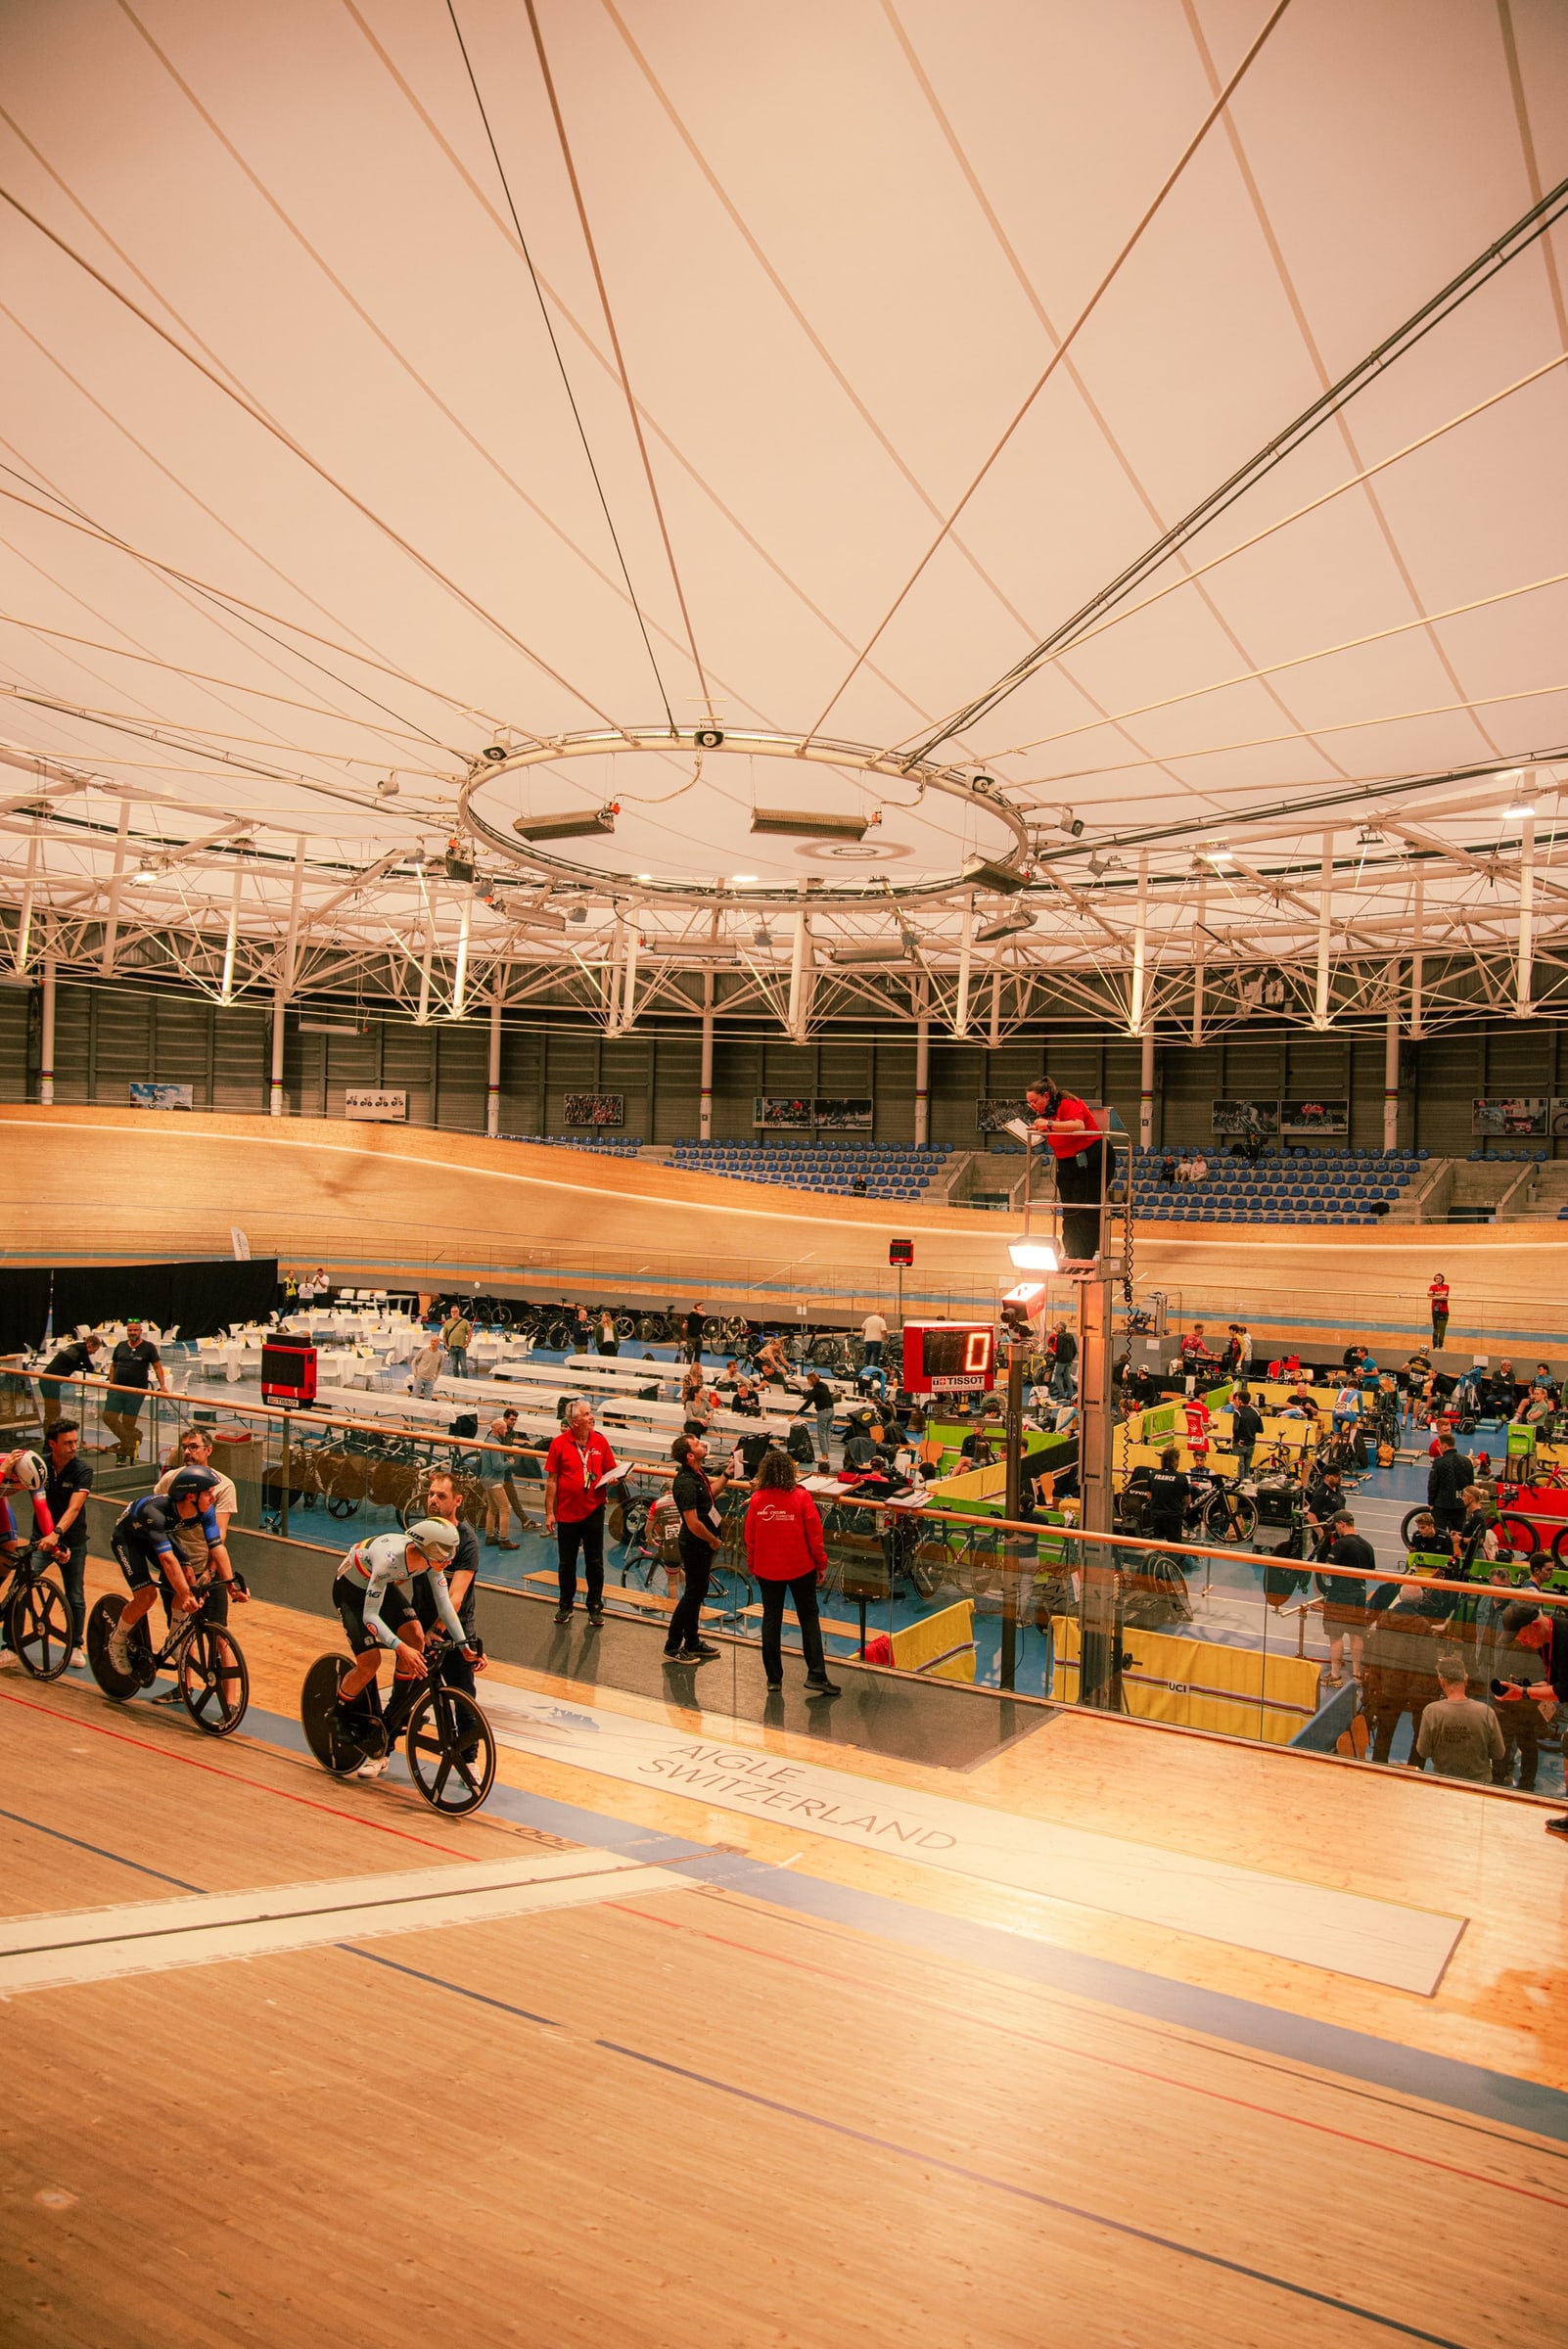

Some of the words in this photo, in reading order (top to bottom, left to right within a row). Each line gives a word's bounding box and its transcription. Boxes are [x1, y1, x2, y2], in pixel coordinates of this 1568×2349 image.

[965, 1332, 991, 1371] 0
[946, 1376, 984, 1385] TISSOT
[407, 1530, 426, 1543] LAZER
[161, 1617, 193, 1657] LOOK
[1168, 1681, 1188, 1693] UCI
[669, 1745, 806, 1784] AIGLE
[637, 1759, 958, 1850] SWITZERLAND
